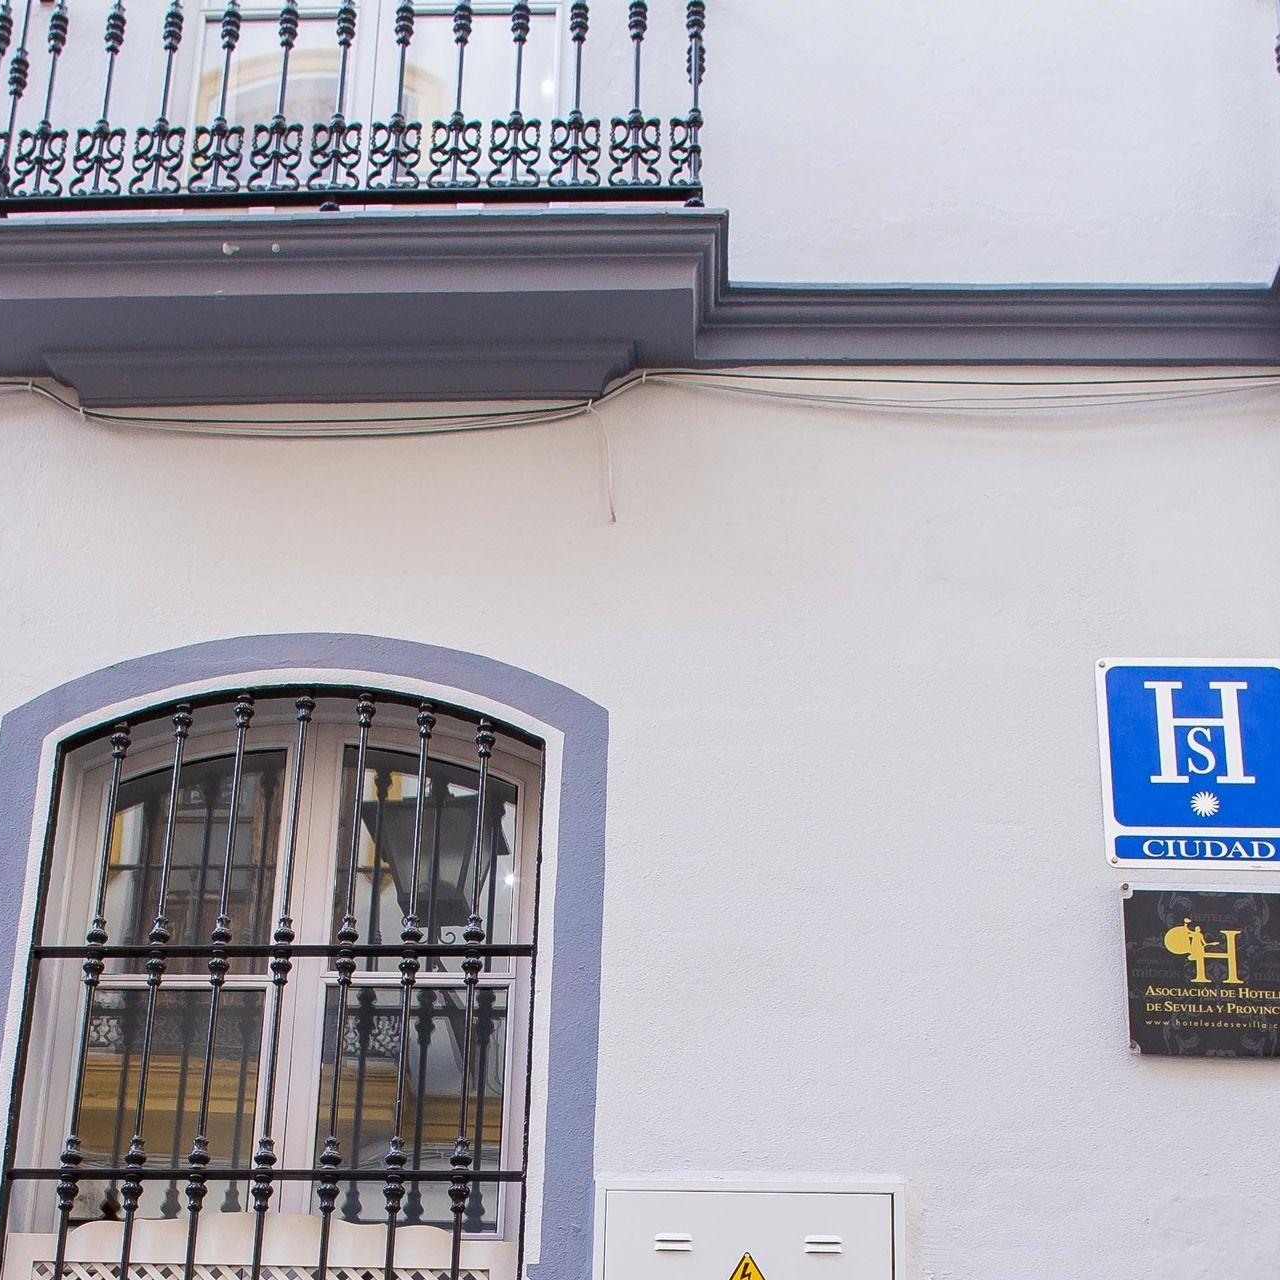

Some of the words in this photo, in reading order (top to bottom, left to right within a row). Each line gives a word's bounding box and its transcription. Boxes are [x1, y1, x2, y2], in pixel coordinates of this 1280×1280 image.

[1142, 839, 1276, 859] CIUDAD
[1145, 985, 1218, 998] ASOCIACIÓN
[1220, 989, 1237, 998] DE
[1146, 1003, 1163, 1012] DE
[1164, 1001, 1214, 1013] SEVILLA
[1216, 1004, 1224, 1013] Y
